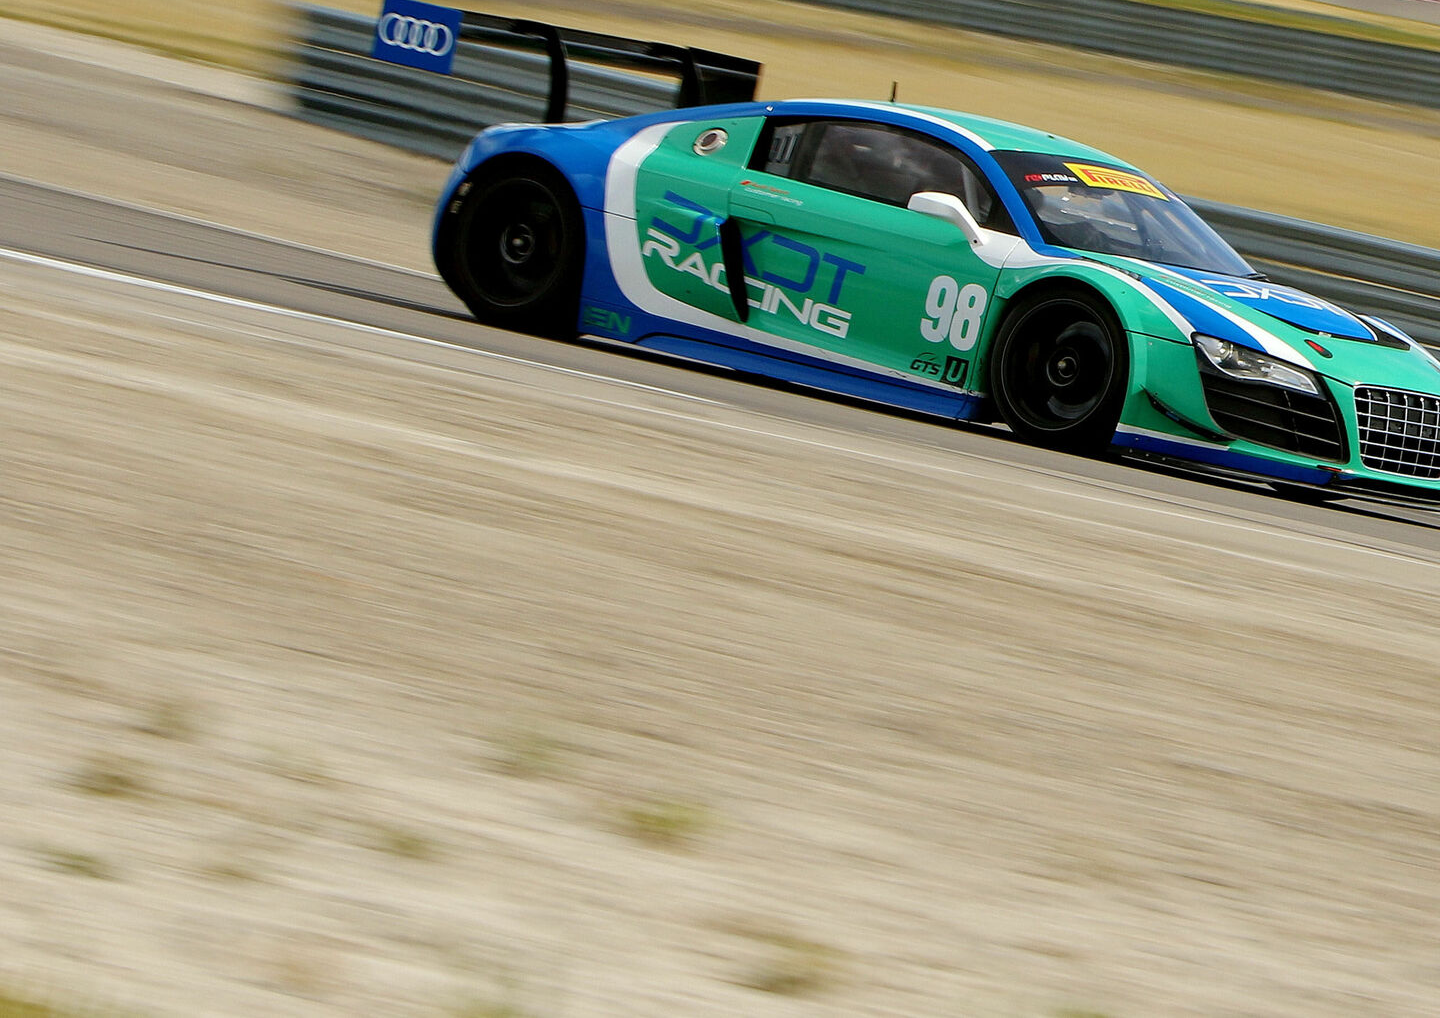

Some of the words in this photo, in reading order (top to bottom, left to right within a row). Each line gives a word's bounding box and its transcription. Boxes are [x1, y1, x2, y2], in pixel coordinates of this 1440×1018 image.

[642, 227, 852, 339] RACING
[920, 274, 988, 352] 98
[909, 359, 942, 376] GTS
